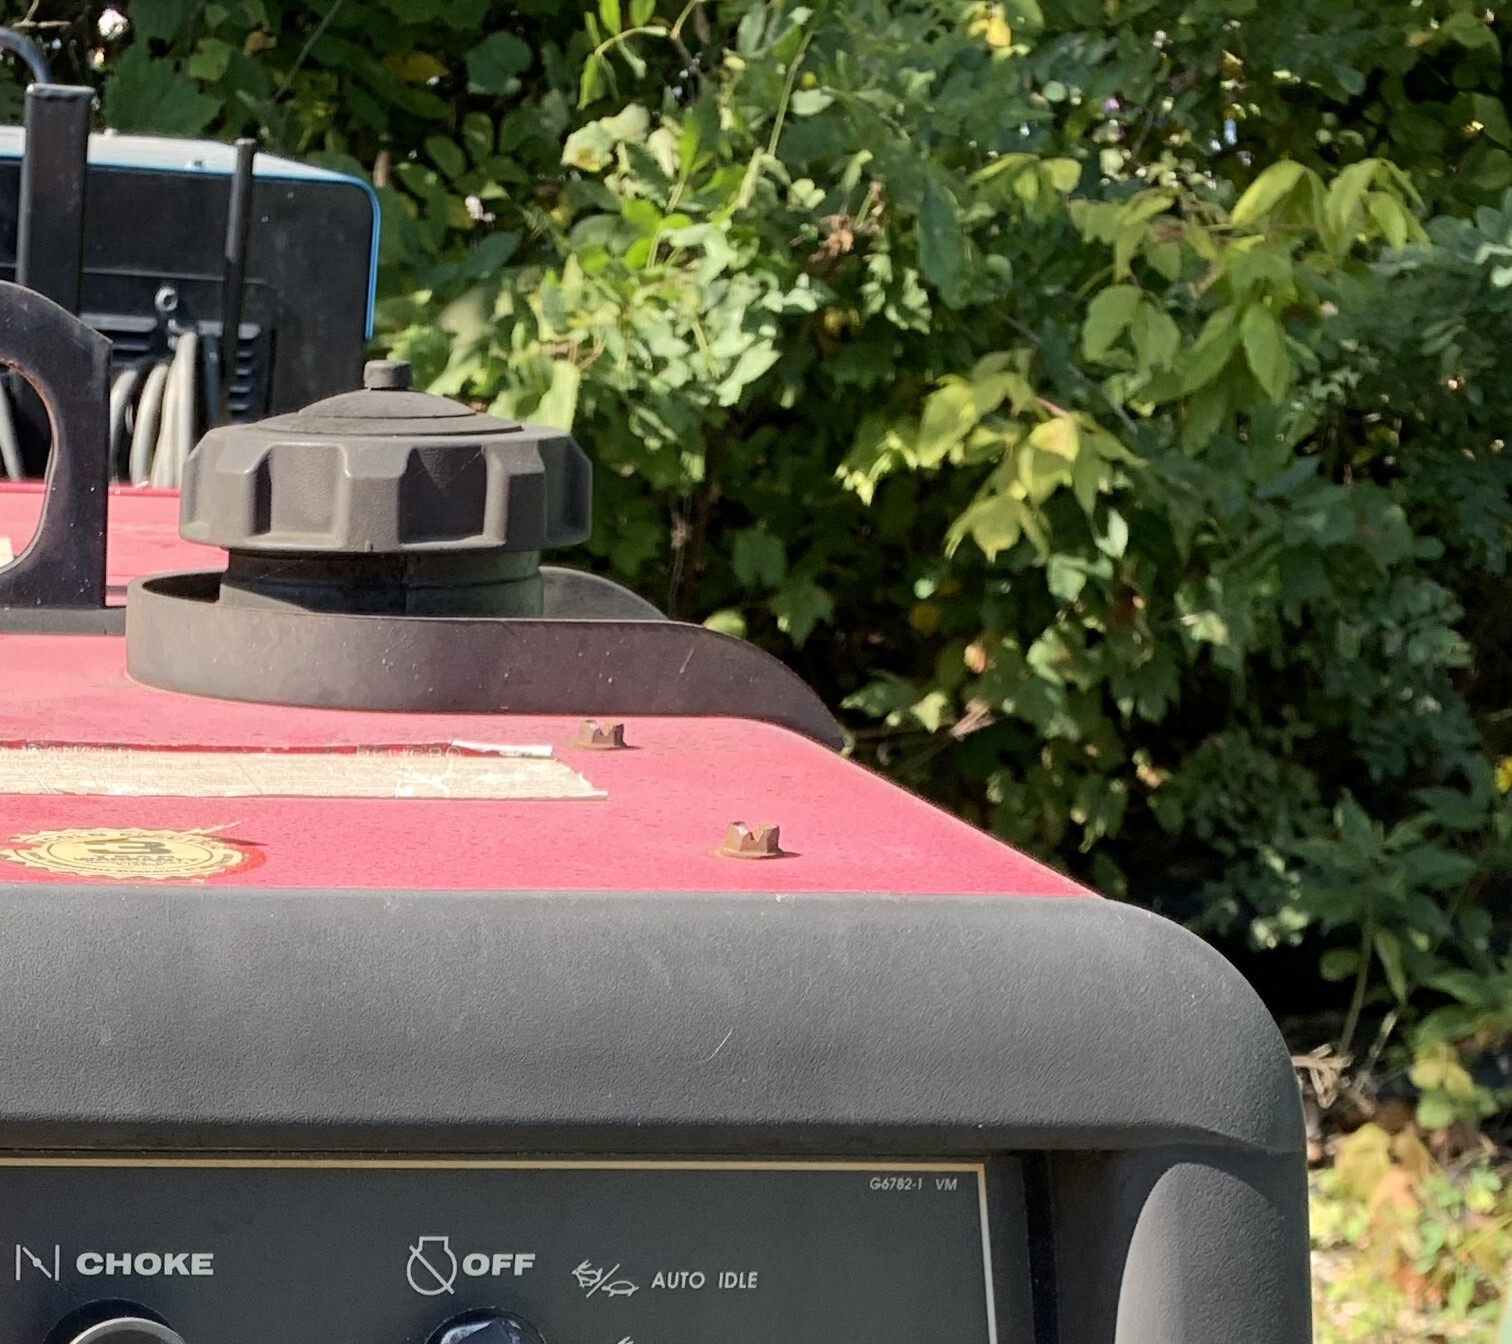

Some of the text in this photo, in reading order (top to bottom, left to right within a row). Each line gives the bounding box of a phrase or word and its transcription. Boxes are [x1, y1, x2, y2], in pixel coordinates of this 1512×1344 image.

[935, 1177, 958, 1190] VM
[76, 1252, 214, 1276] CHOKE
[462, 1253, 536, 1277] OFF
[651, 1271, 759, 1289] AUTO IDLE
